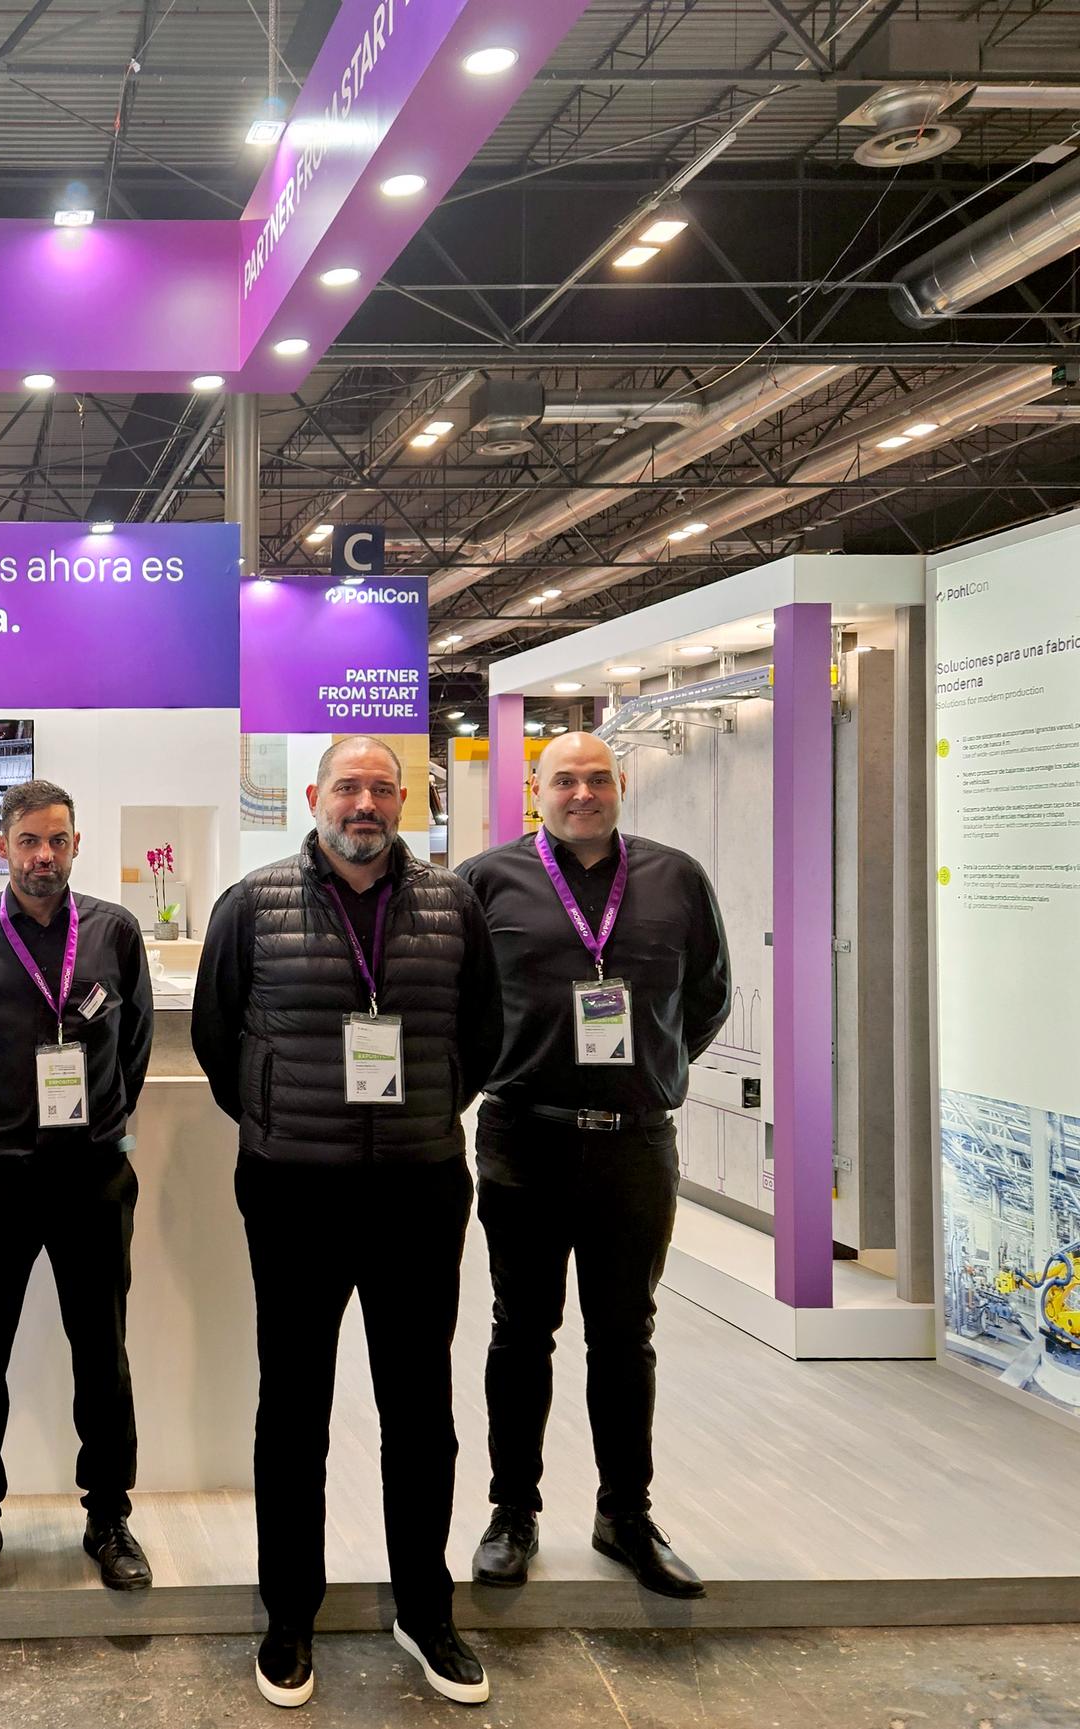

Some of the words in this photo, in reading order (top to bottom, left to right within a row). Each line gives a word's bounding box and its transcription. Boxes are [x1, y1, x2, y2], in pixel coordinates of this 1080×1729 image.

[243, 183, 295, 300] PARTNER
[344, 532, 373, 571] C
[27, 549, 132, 583] ahora
[141, 557, 184, 583] es
[345, 587, 419, 604] PohlCon
[947, 580, 989, 601] PohlCon
[937, 657, 994, 675] Soluciones
[996, 649, 1020, 667] para
[1023, 644, 1043, 659] una
[346, 669, 419, 683] PARTNER
[937, 676, 984, 694] moderna
[318, 686, 367, 700] FROM
[369, 686, 419, 700] START
[326, 703, 349, 717] TO
[351, 703, 418, 717] FUTURE.
